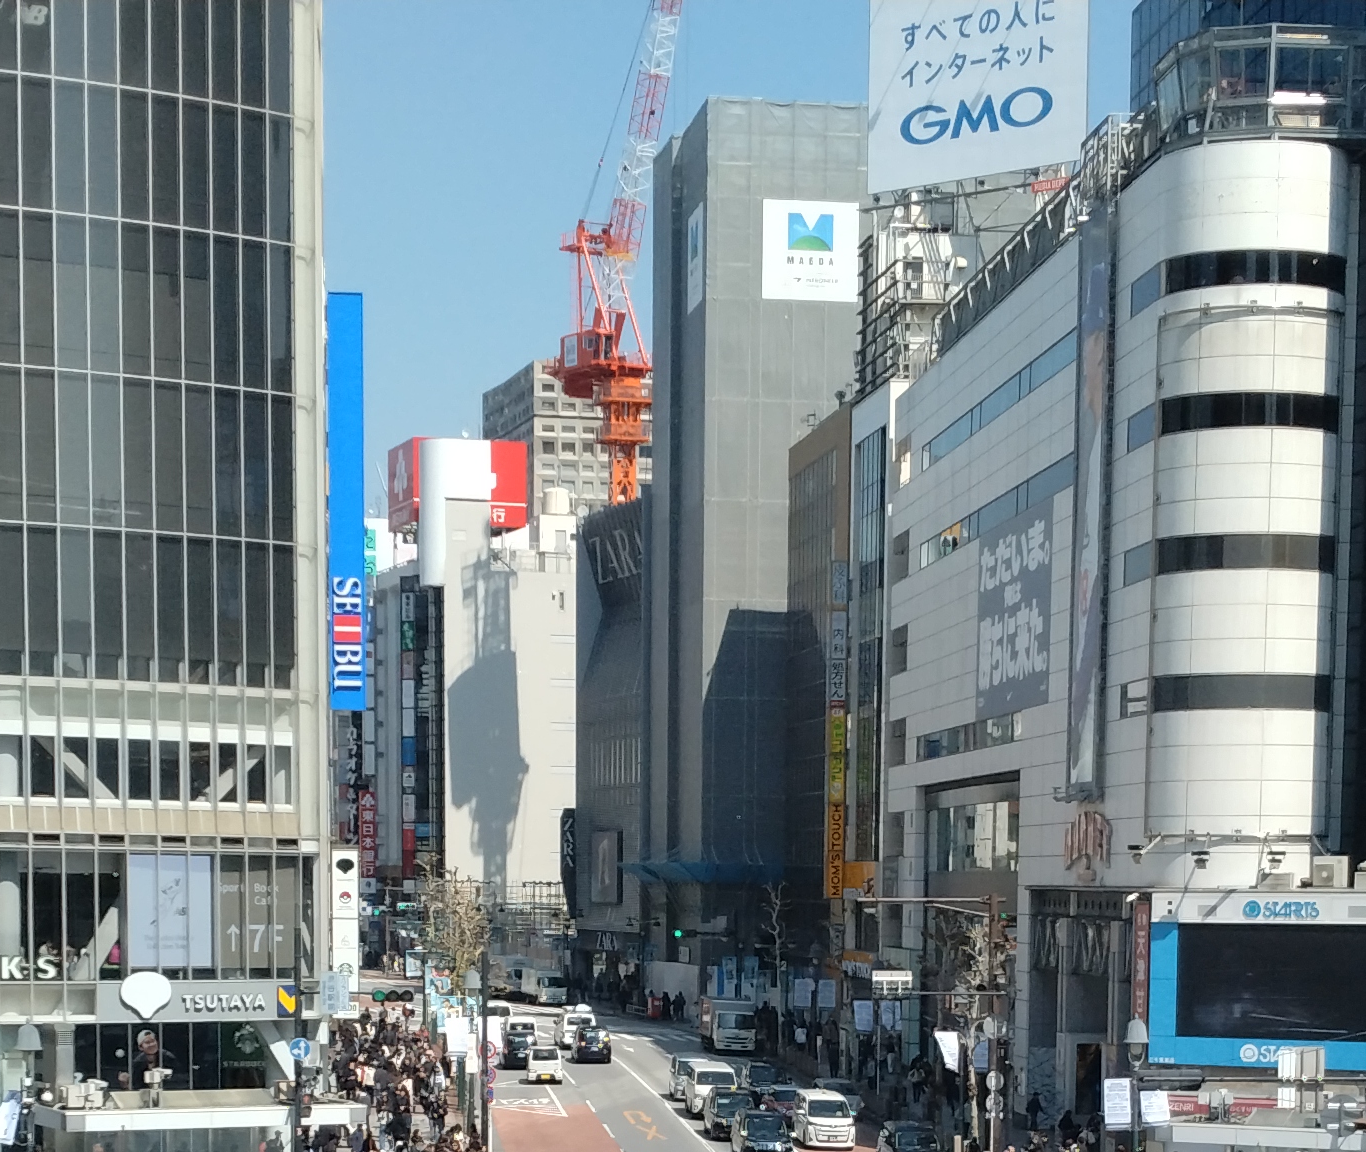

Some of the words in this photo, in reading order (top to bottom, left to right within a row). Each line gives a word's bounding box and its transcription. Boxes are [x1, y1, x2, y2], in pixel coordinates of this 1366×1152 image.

[901, 0, 1055, 51] すべての人に
[901, 36, 1054, 88] インターネット
[900, 86, 1053, 145] GMO
[563, 818, 575, 868] ZARA
[831, 804, 841, 850] TOUCH
[1263, 902, 1320, 919] STARTS
[596, 932, 619, 950] ZARA
[182, 994, 267, 1012] TSUTAYA
